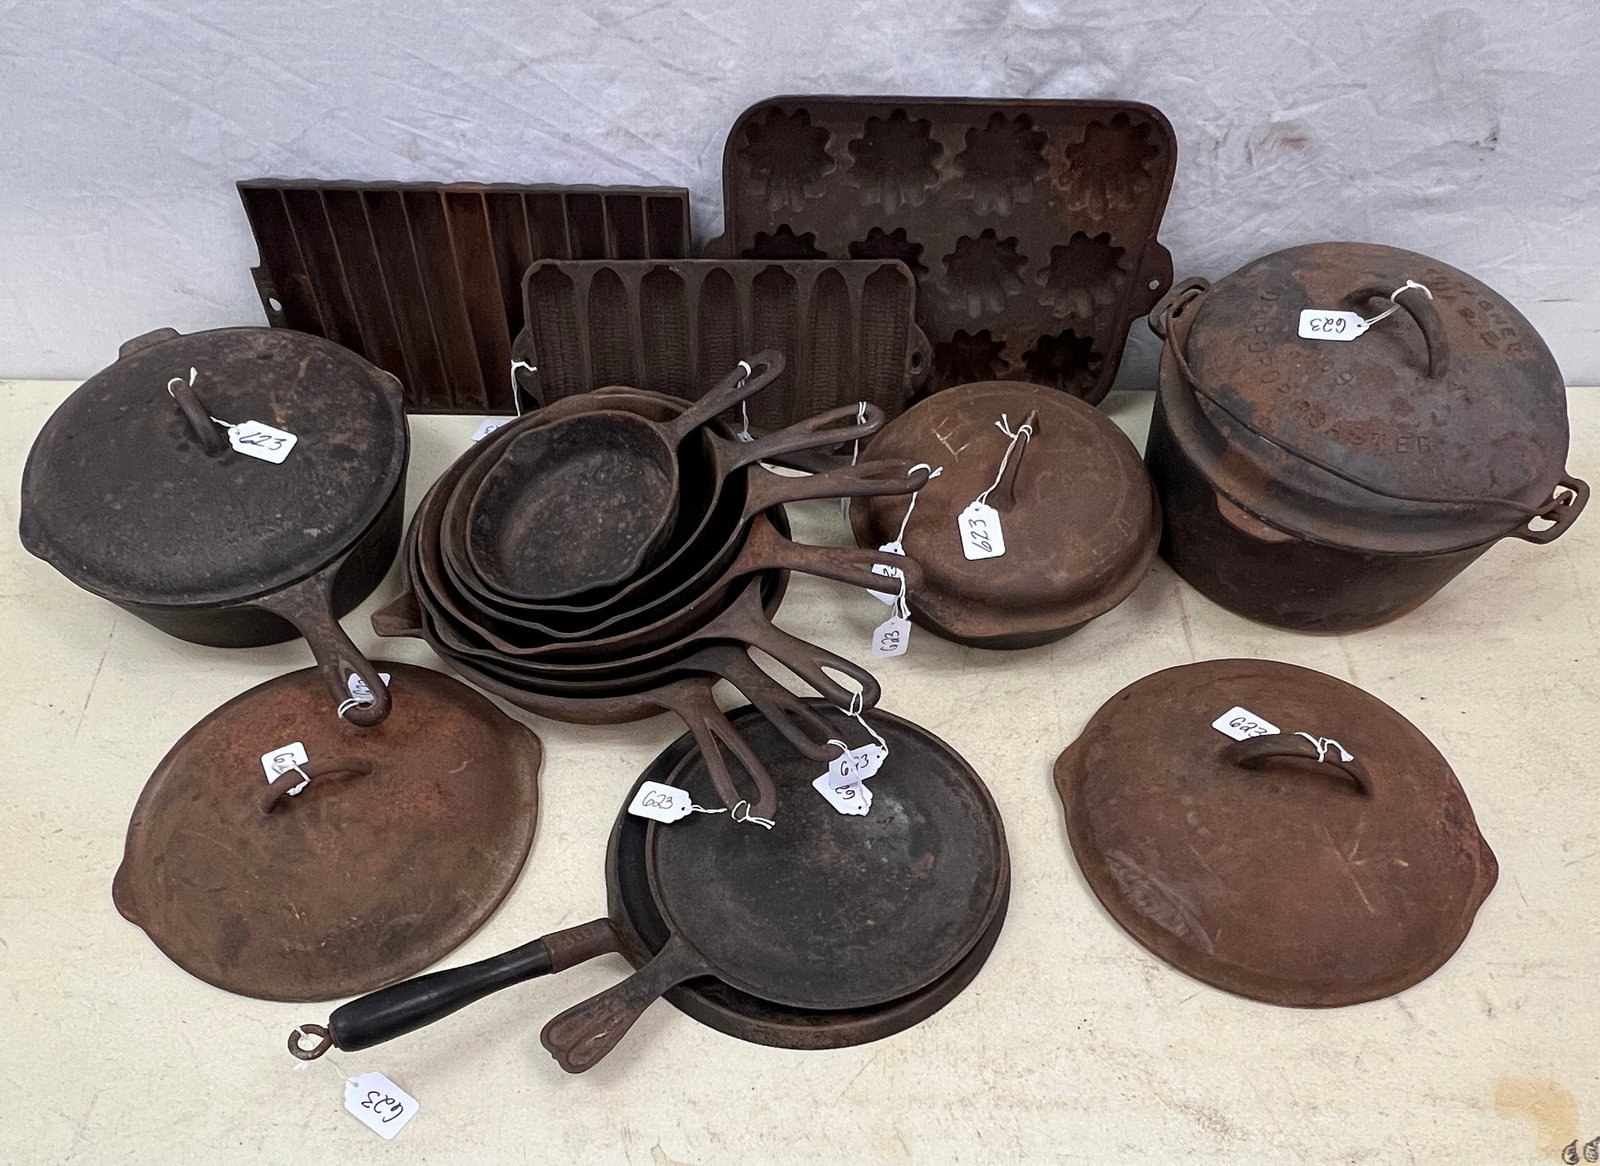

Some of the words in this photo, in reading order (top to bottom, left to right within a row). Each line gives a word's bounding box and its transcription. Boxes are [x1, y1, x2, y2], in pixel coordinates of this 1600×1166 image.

[1309, 317, 1347, 334] 623
[238, 431, 288, 451] 623
[968, 518, 993, 553] 623
[880, 630, 900, 652] 623
[641, 790, 674, 810] 623
[360, 1090, 404, 1123] 623
